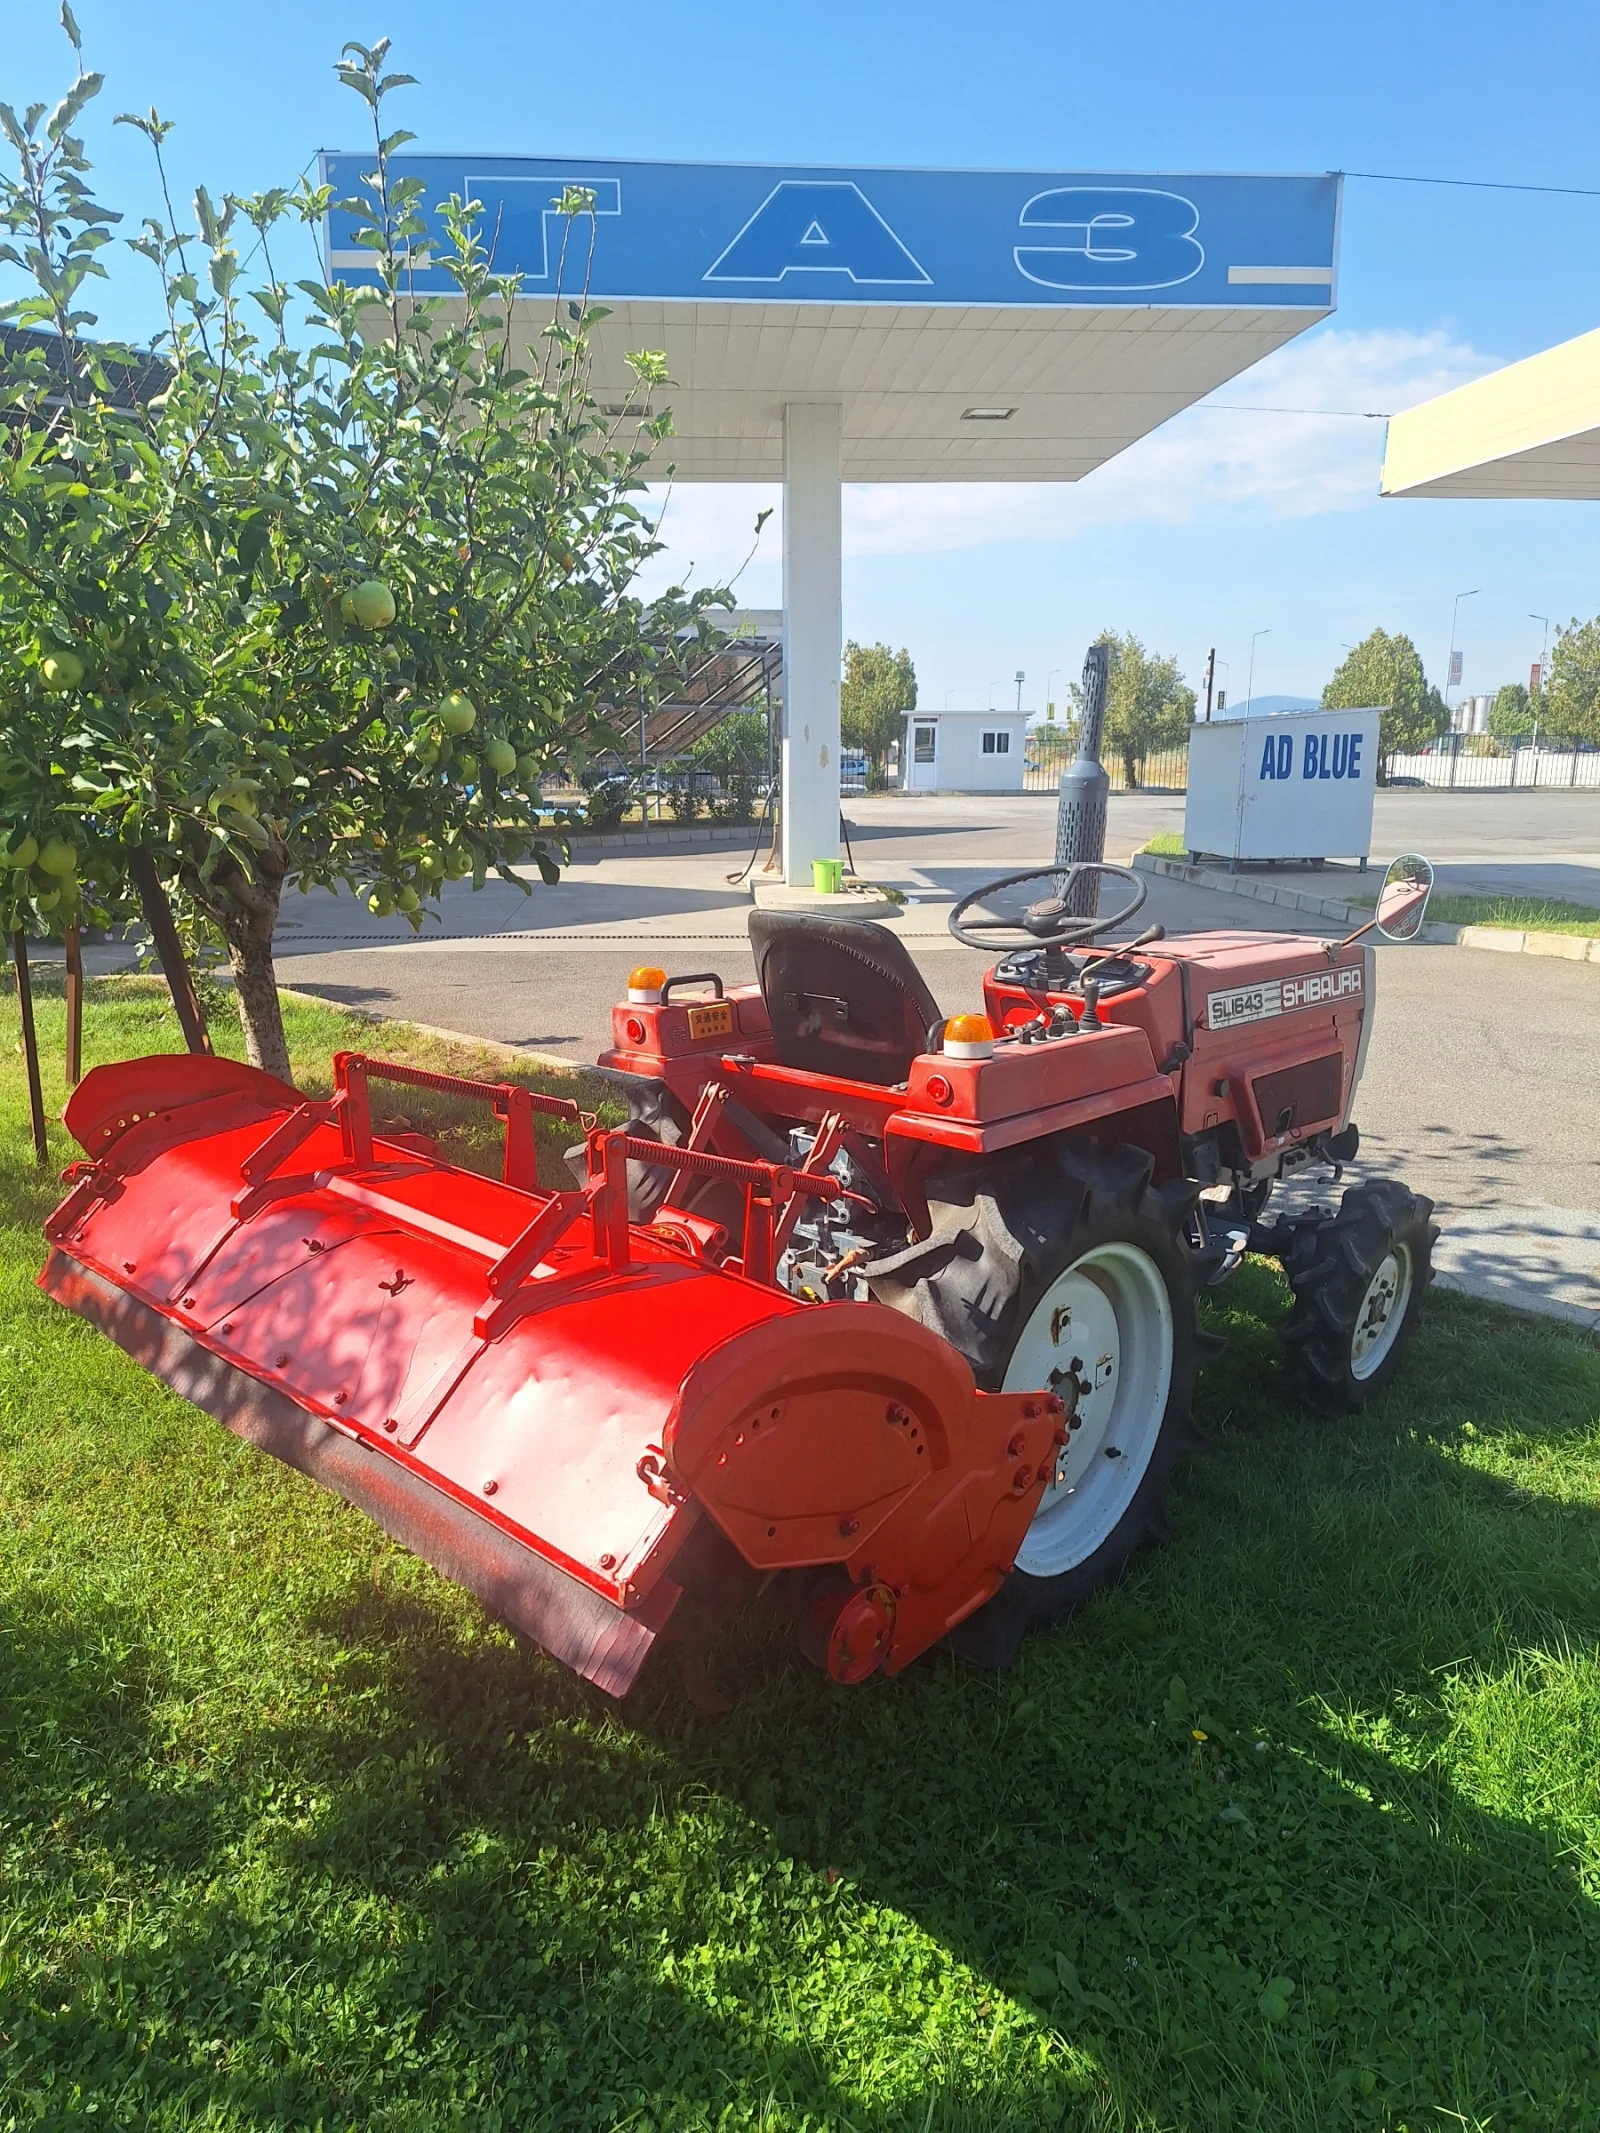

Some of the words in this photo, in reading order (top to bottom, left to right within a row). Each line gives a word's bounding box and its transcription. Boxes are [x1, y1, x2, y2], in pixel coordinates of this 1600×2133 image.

[464, 176, 1205, 290] ГАЗ
[1260, 735, 1293, 780] AD
[1303, 734, 1363, 780] BLUE
[1282, 969, 1362, 1008] SHIBAURA
